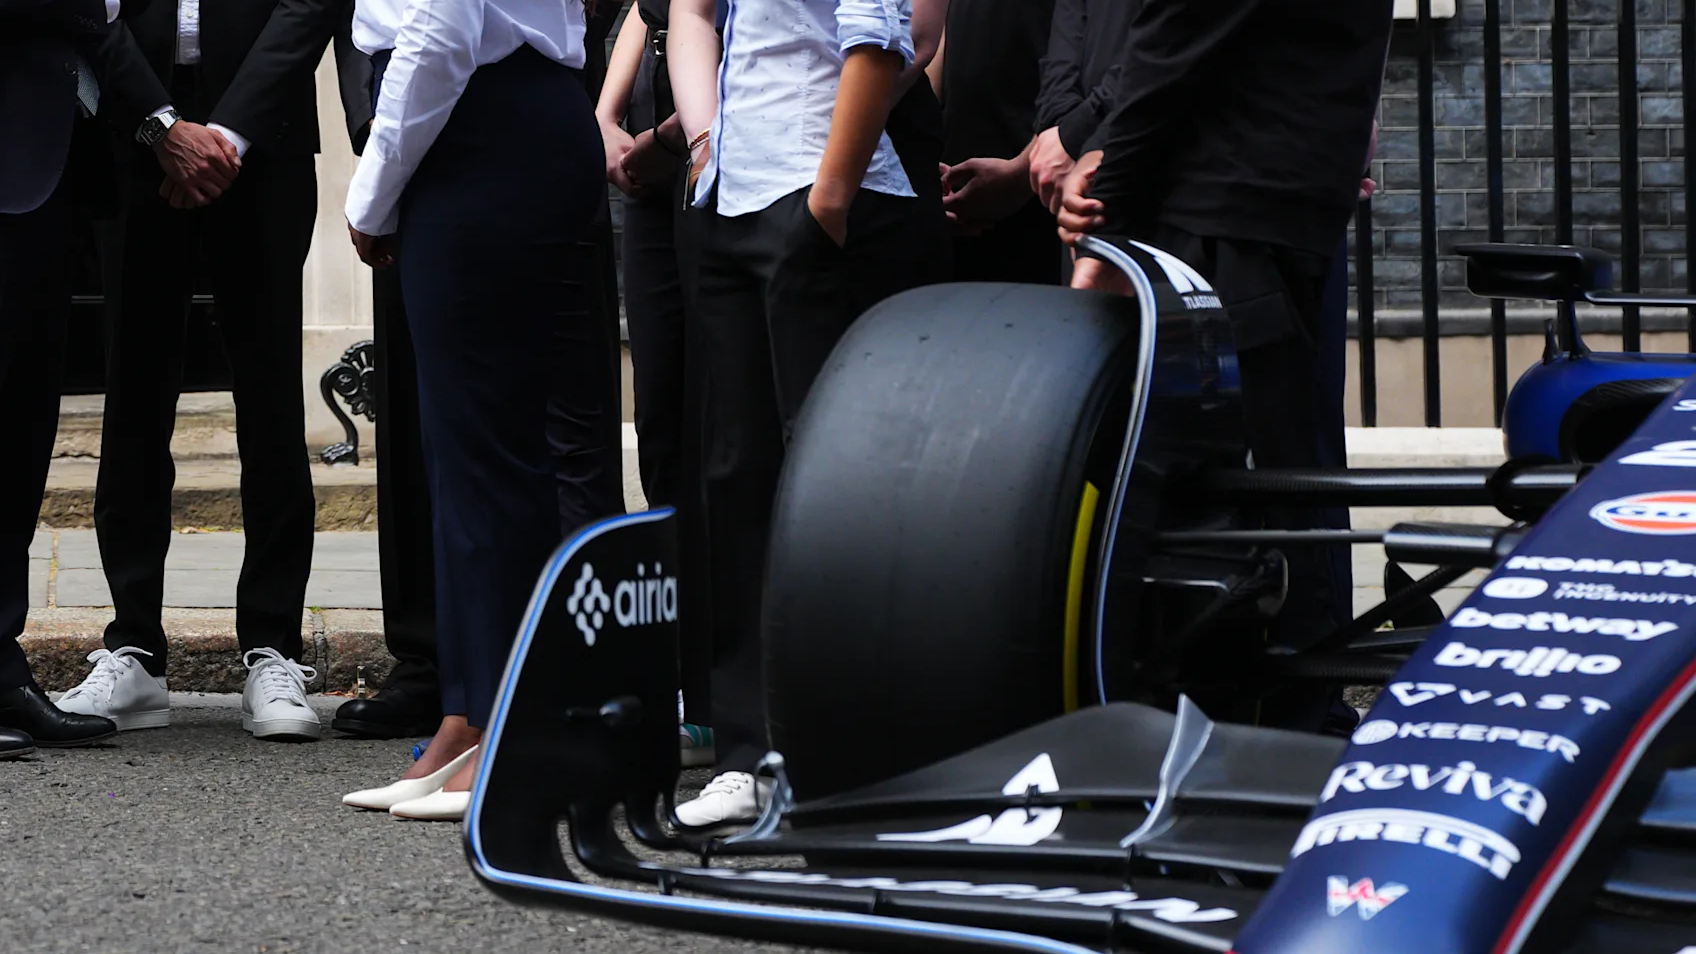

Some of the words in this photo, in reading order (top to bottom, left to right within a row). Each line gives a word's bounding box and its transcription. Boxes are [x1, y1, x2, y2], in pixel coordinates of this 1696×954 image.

[1506, 556, 1696, 577] KOMATS
[614, 561, 677, 627] airia
[1449, 607, 1680, 641] betway
[1459, 689, 1612, 715] VAST
[1398, 722, 1581, 763] KEEPER
[1319, 760, 1548, 826] Reviva
[1289, 808, 1522, 881] PIRELLI
